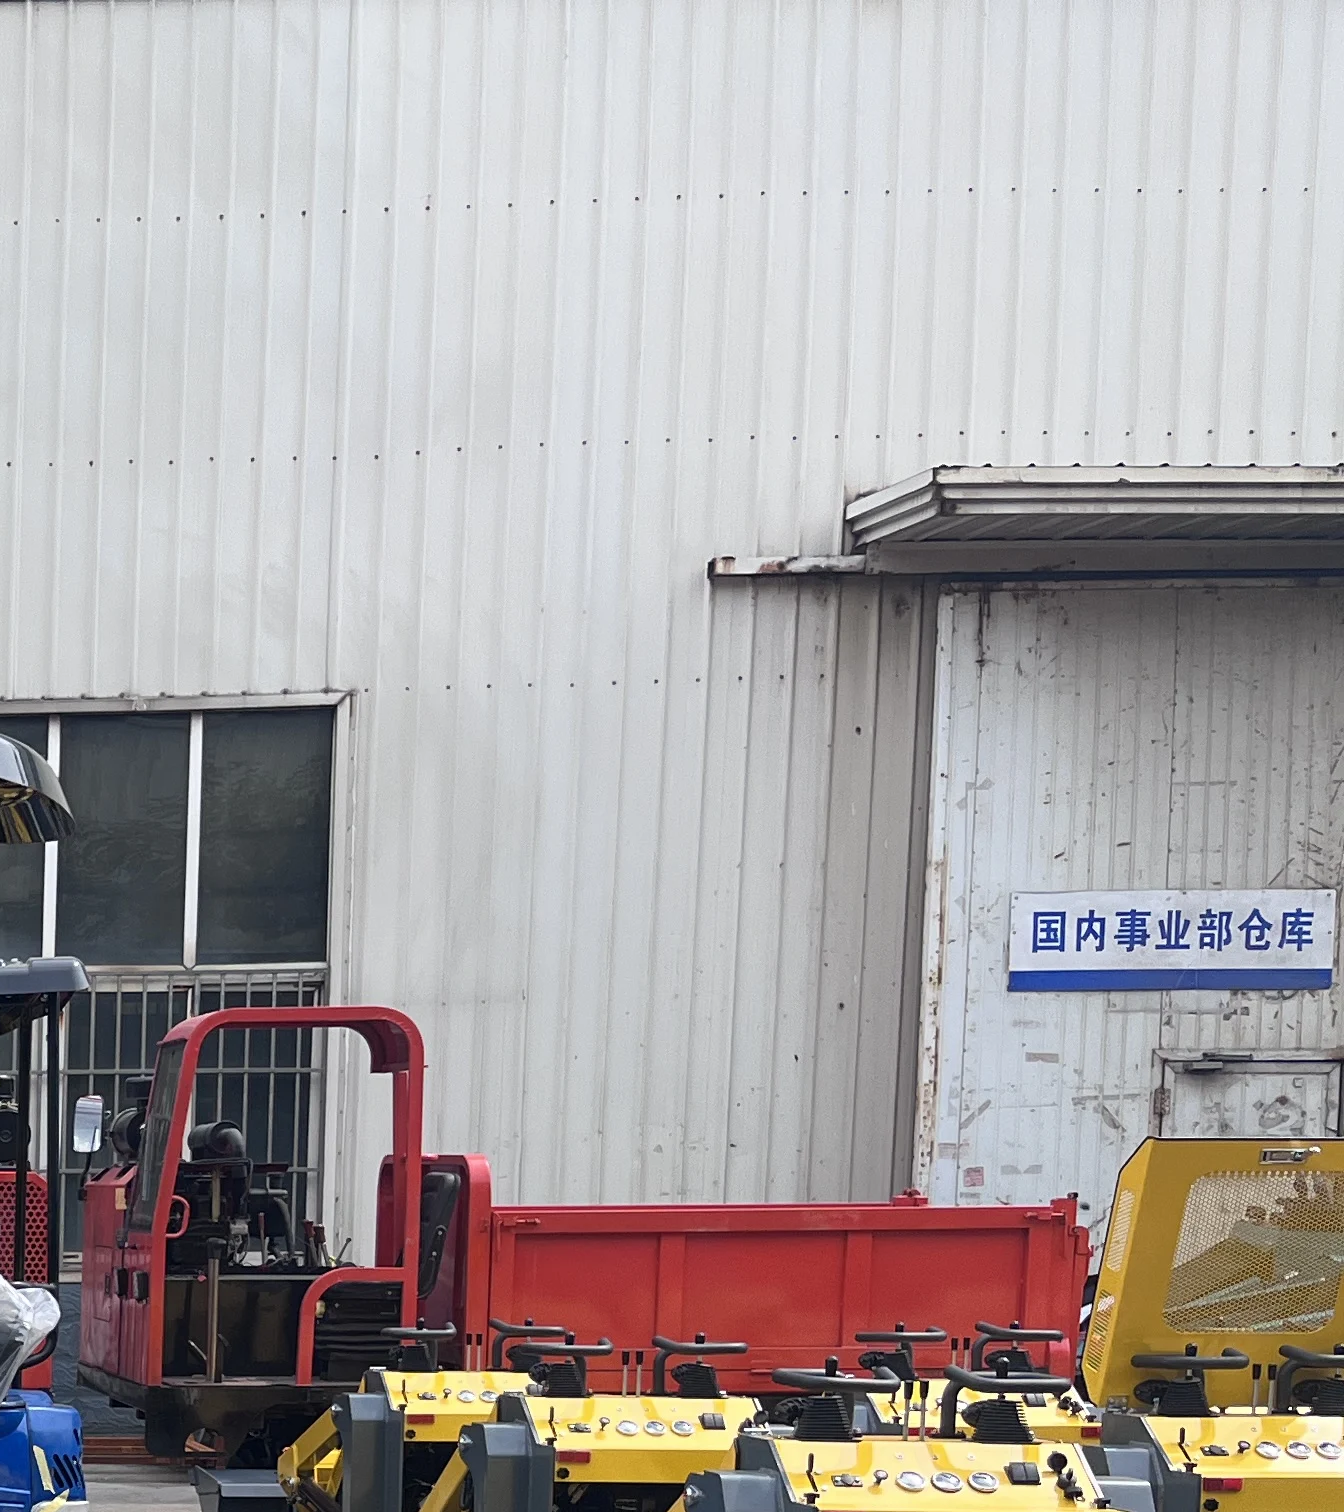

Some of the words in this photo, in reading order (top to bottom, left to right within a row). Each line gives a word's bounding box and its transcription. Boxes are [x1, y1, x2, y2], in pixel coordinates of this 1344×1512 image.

[1031, 907, 1315, 954] 国内事业部仓库
